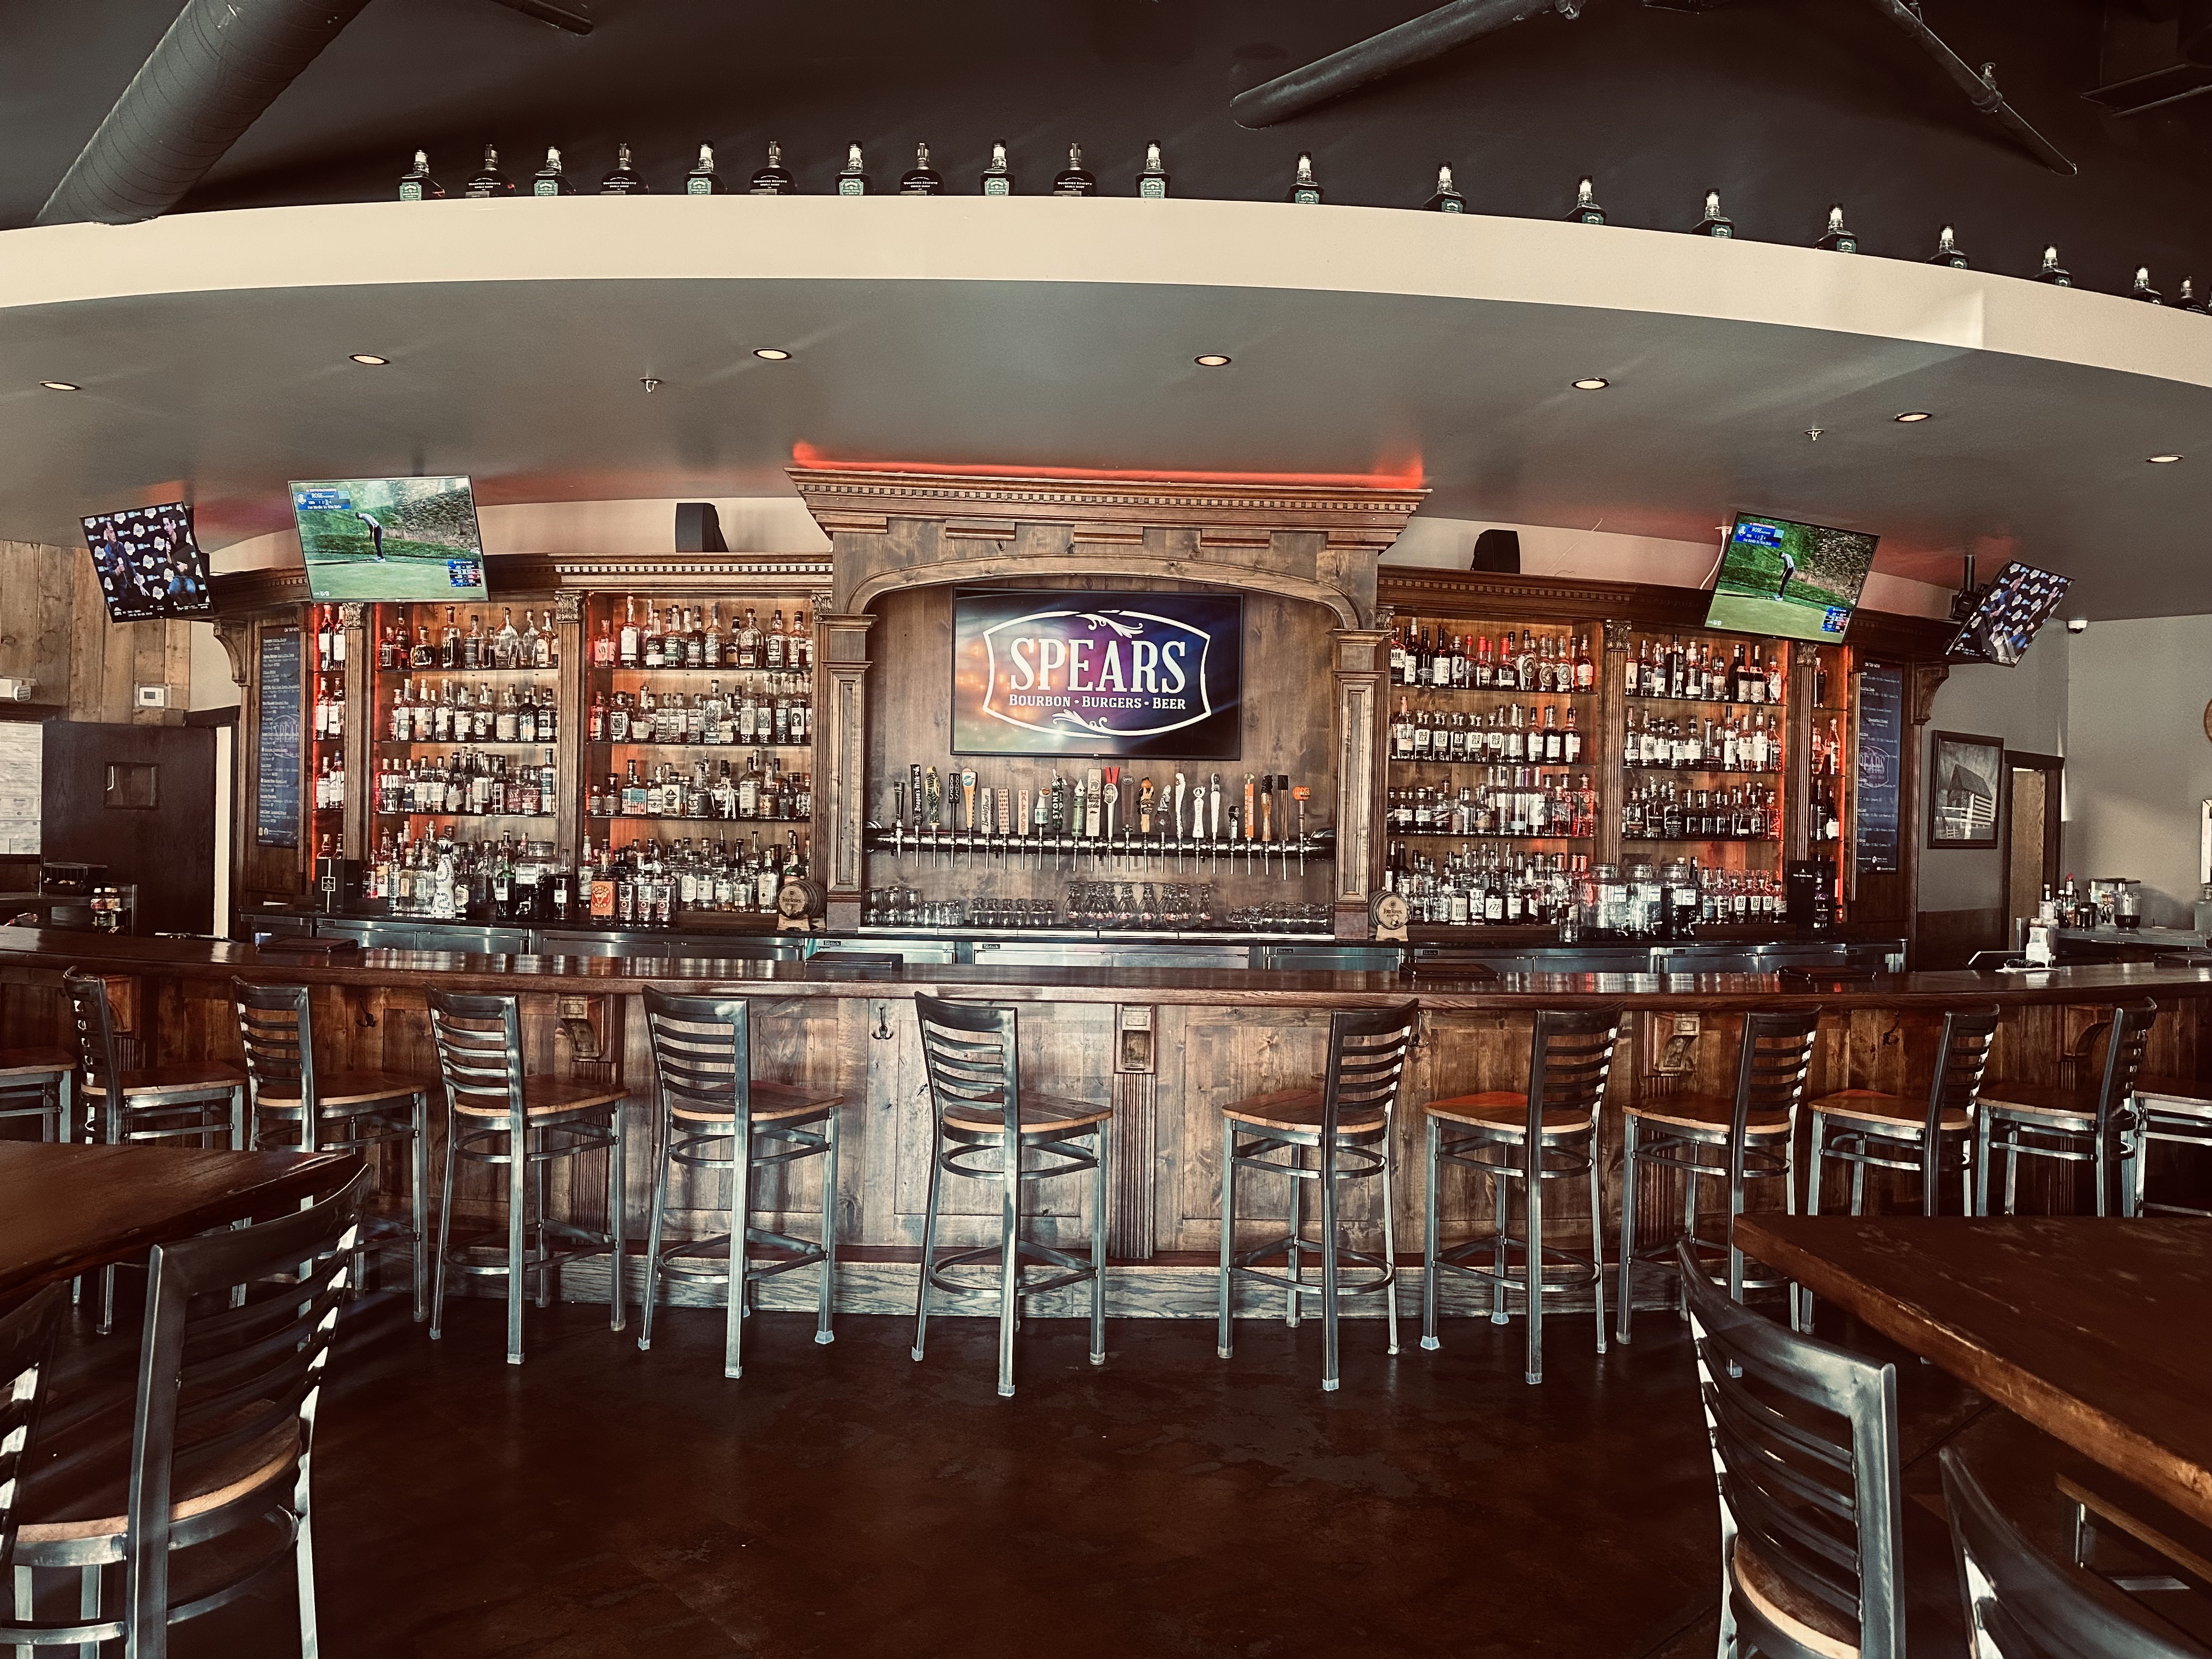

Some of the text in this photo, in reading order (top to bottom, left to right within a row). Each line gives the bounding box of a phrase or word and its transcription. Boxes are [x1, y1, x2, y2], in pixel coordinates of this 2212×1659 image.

[1010, 637, 1186, 694] SPEARS
[1009, 694, 1186, 709] BOURBON BURGERS BEER
[592, 886, 610, 894] HOWLER
